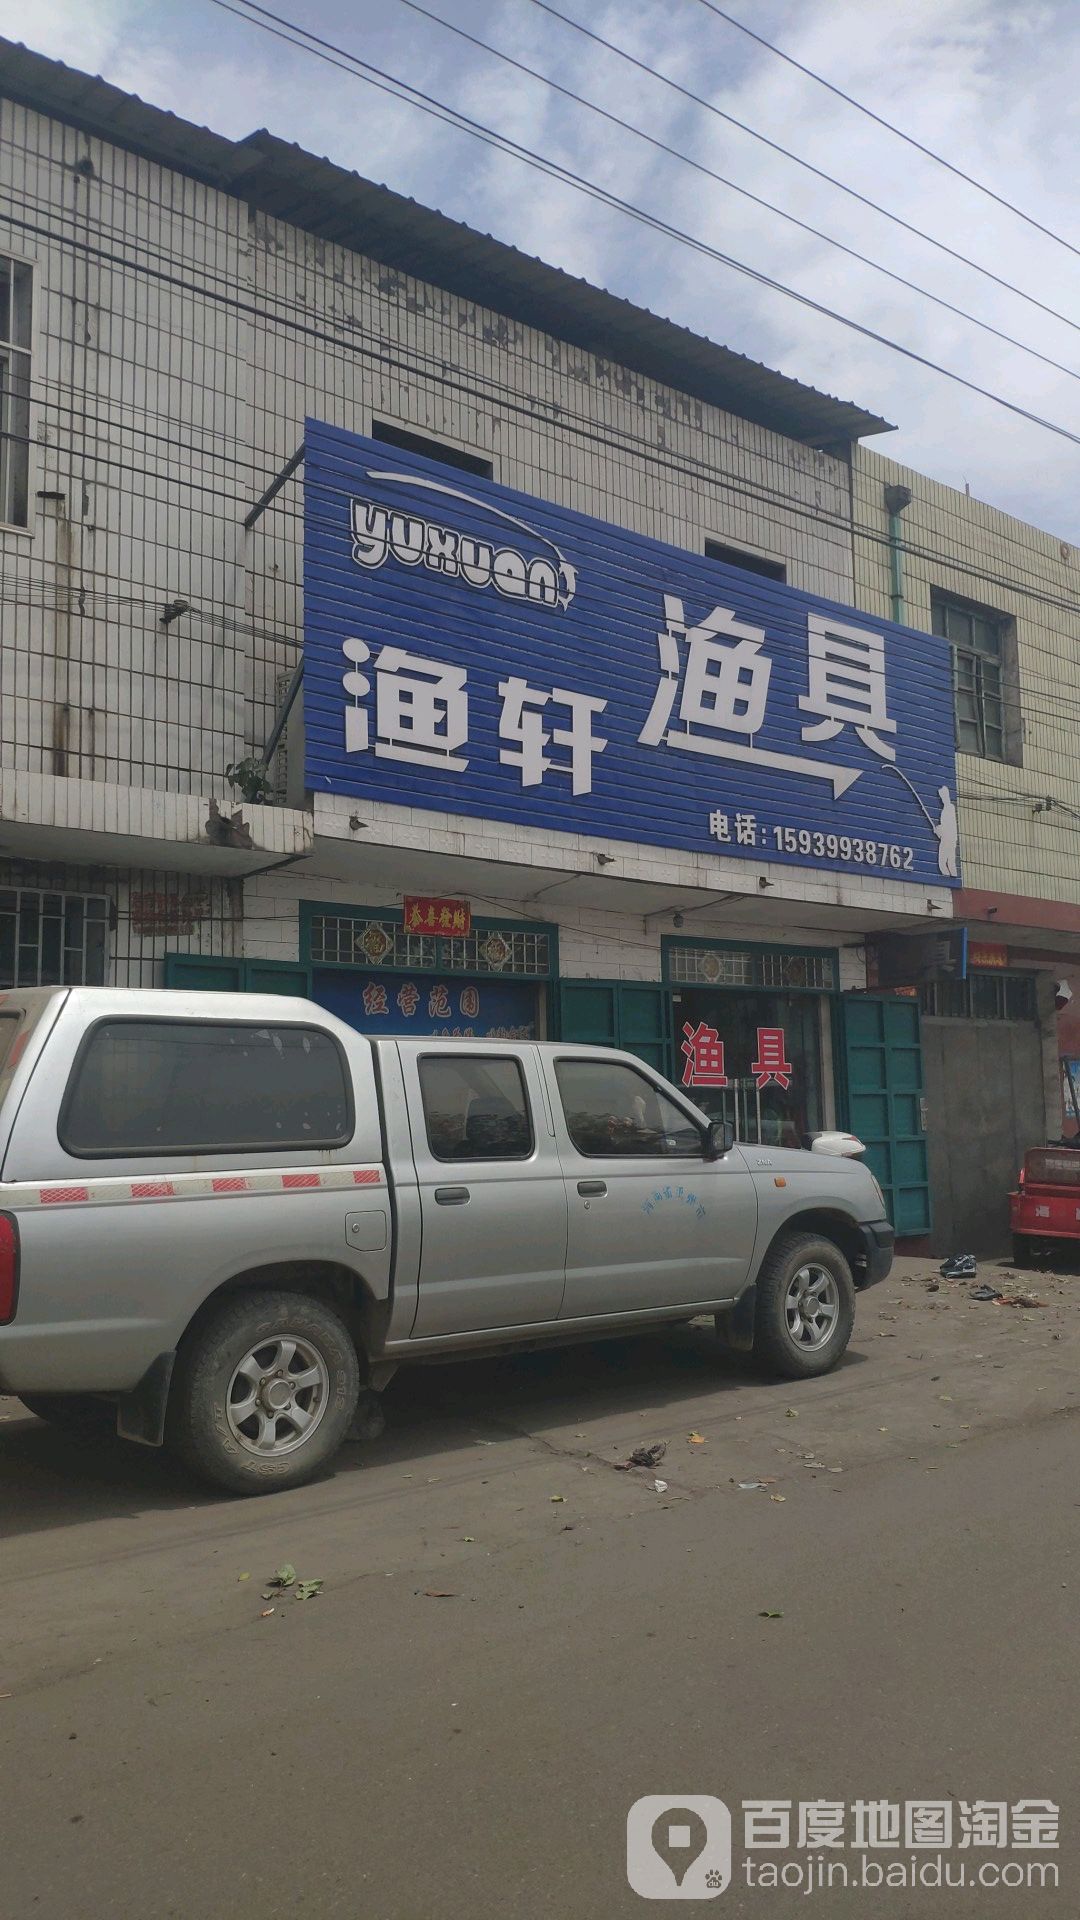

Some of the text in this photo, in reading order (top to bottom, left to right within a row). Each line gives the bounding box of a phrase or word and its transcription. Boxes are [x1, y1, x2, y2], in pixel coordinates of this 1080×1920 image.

[350, 499, 561, 608] yuxuan
[343, 593, 898, 800] 渔轩 渔具
[362, 981, 481, 1019] 经营范围
[681, 1022, 792, 1089] 渔具
